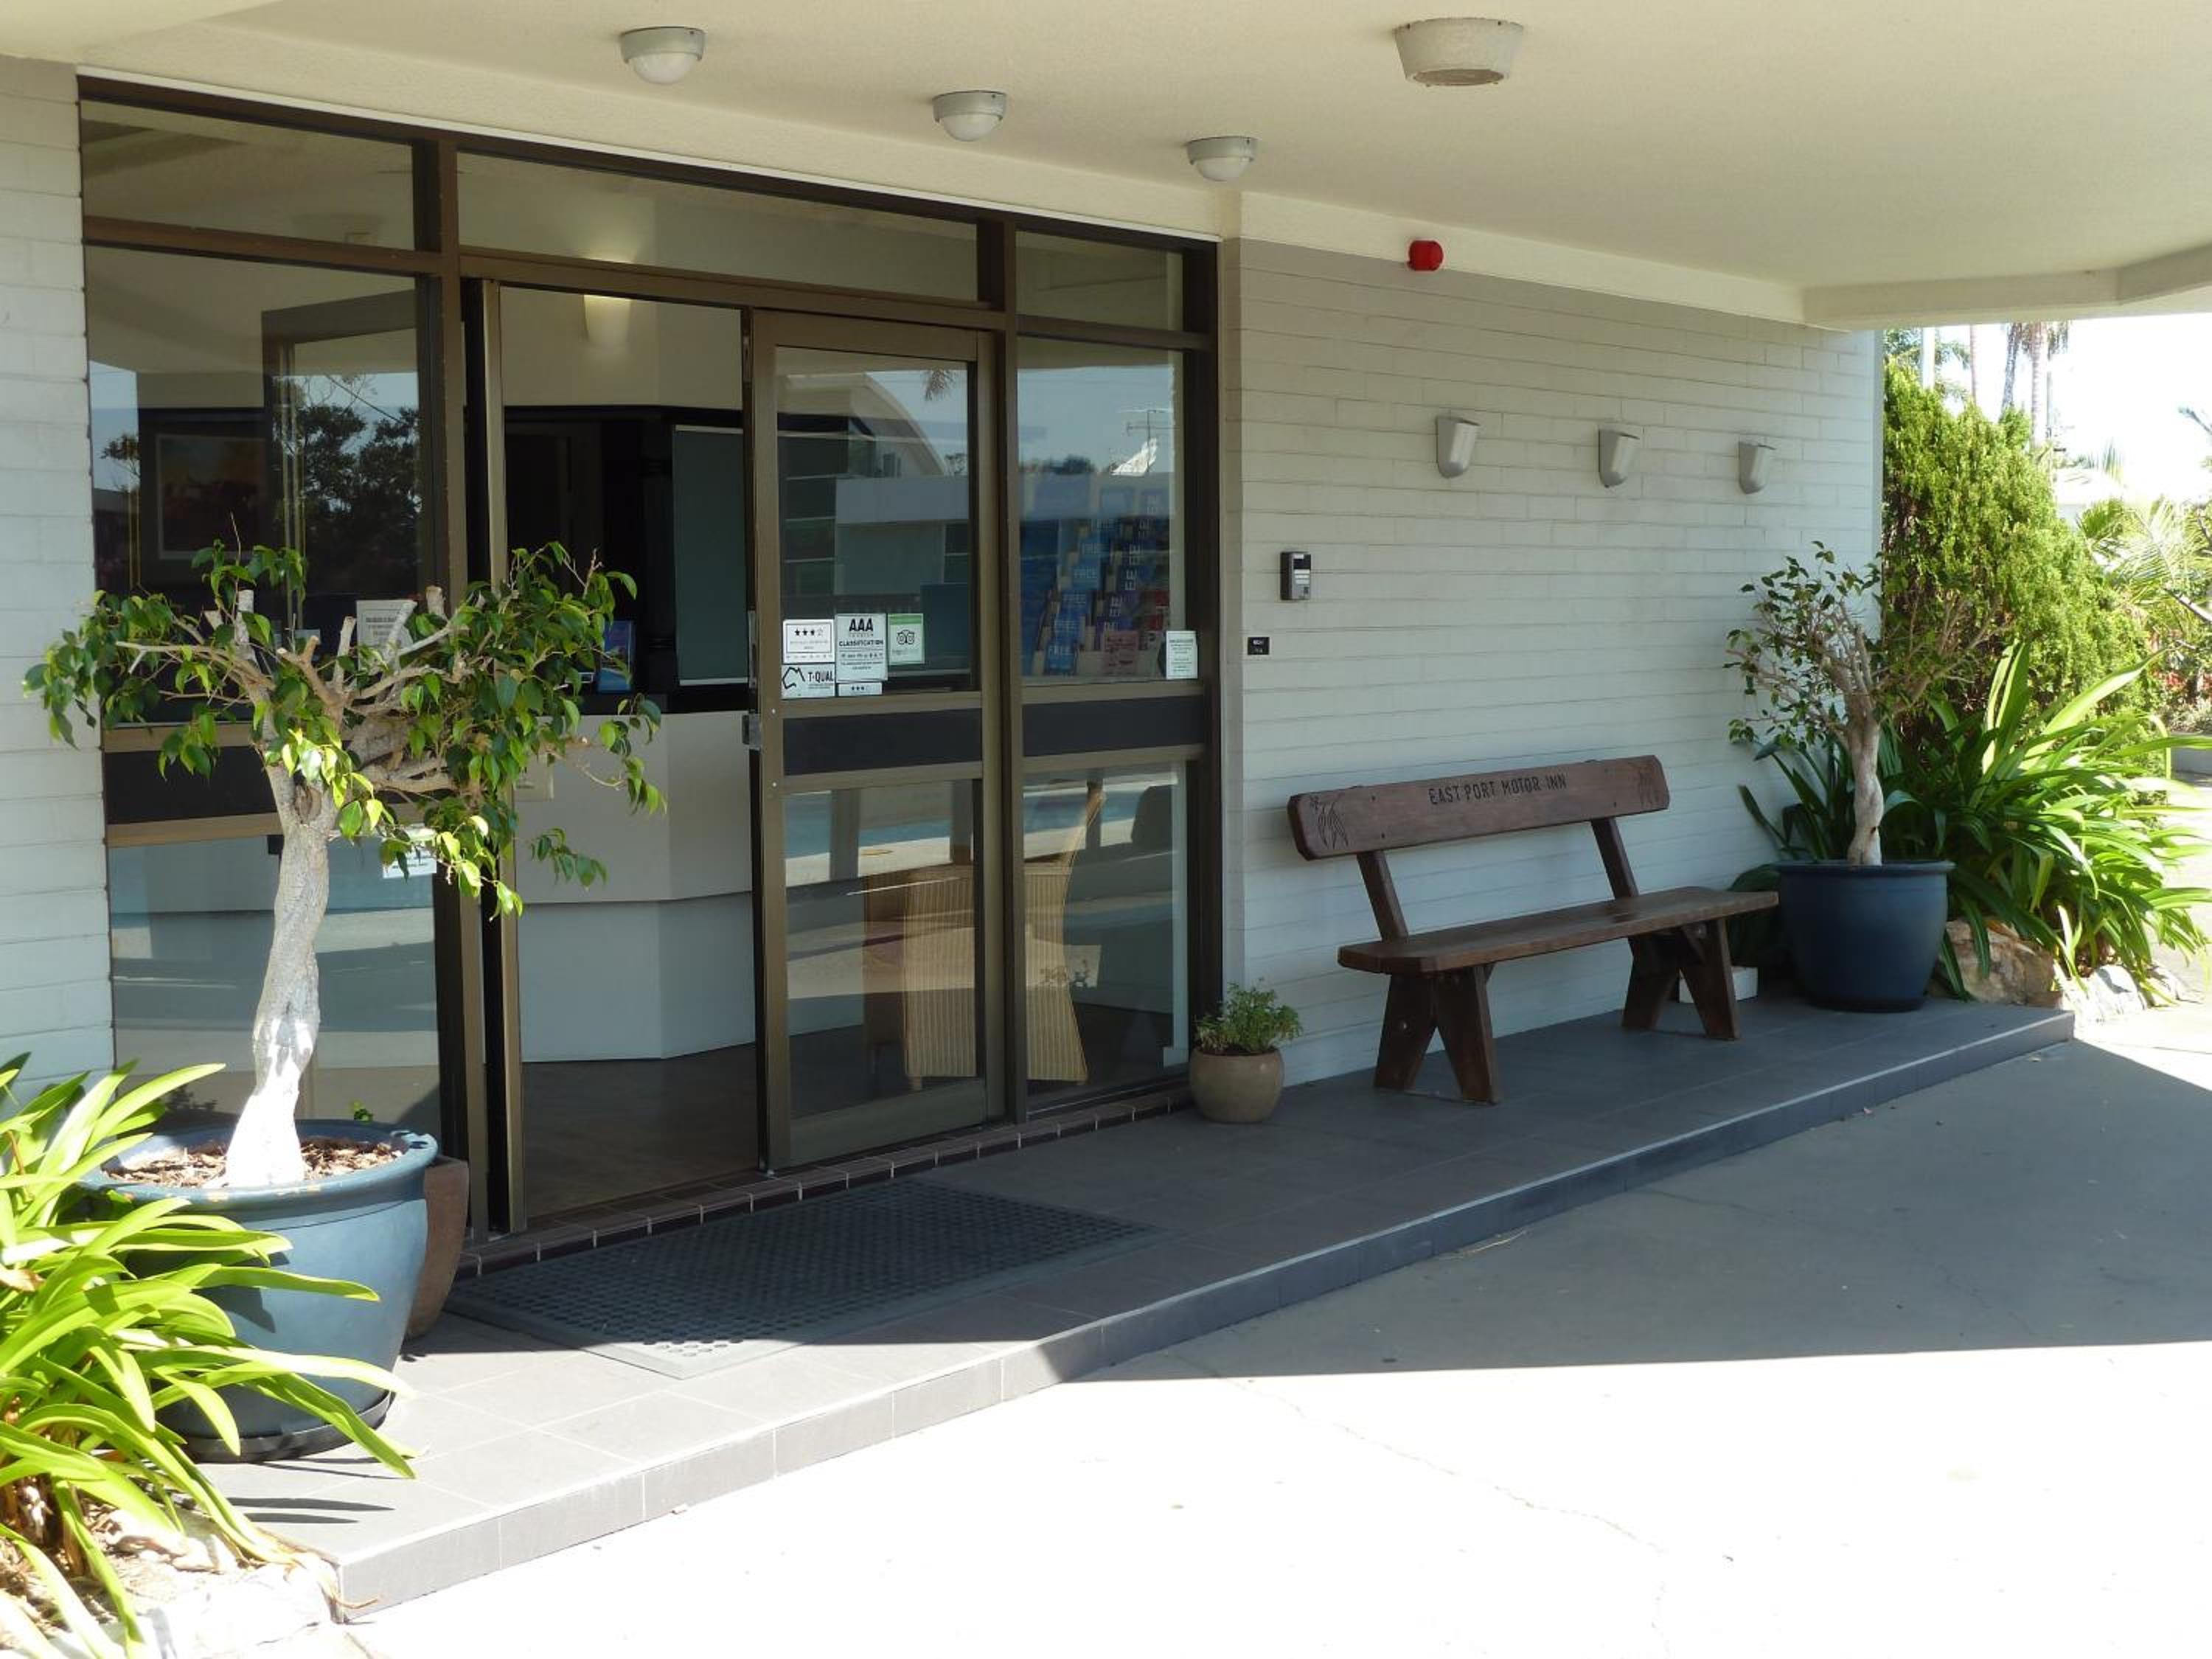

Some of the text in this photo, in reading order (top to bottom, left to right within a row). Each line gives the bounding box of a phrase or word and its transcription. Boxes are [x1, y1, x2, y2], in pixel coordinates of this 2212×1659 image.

[849, 618, 874, 632] AAA
[1428, 773, 1567, 805] EAST PORT MOTOR INN
